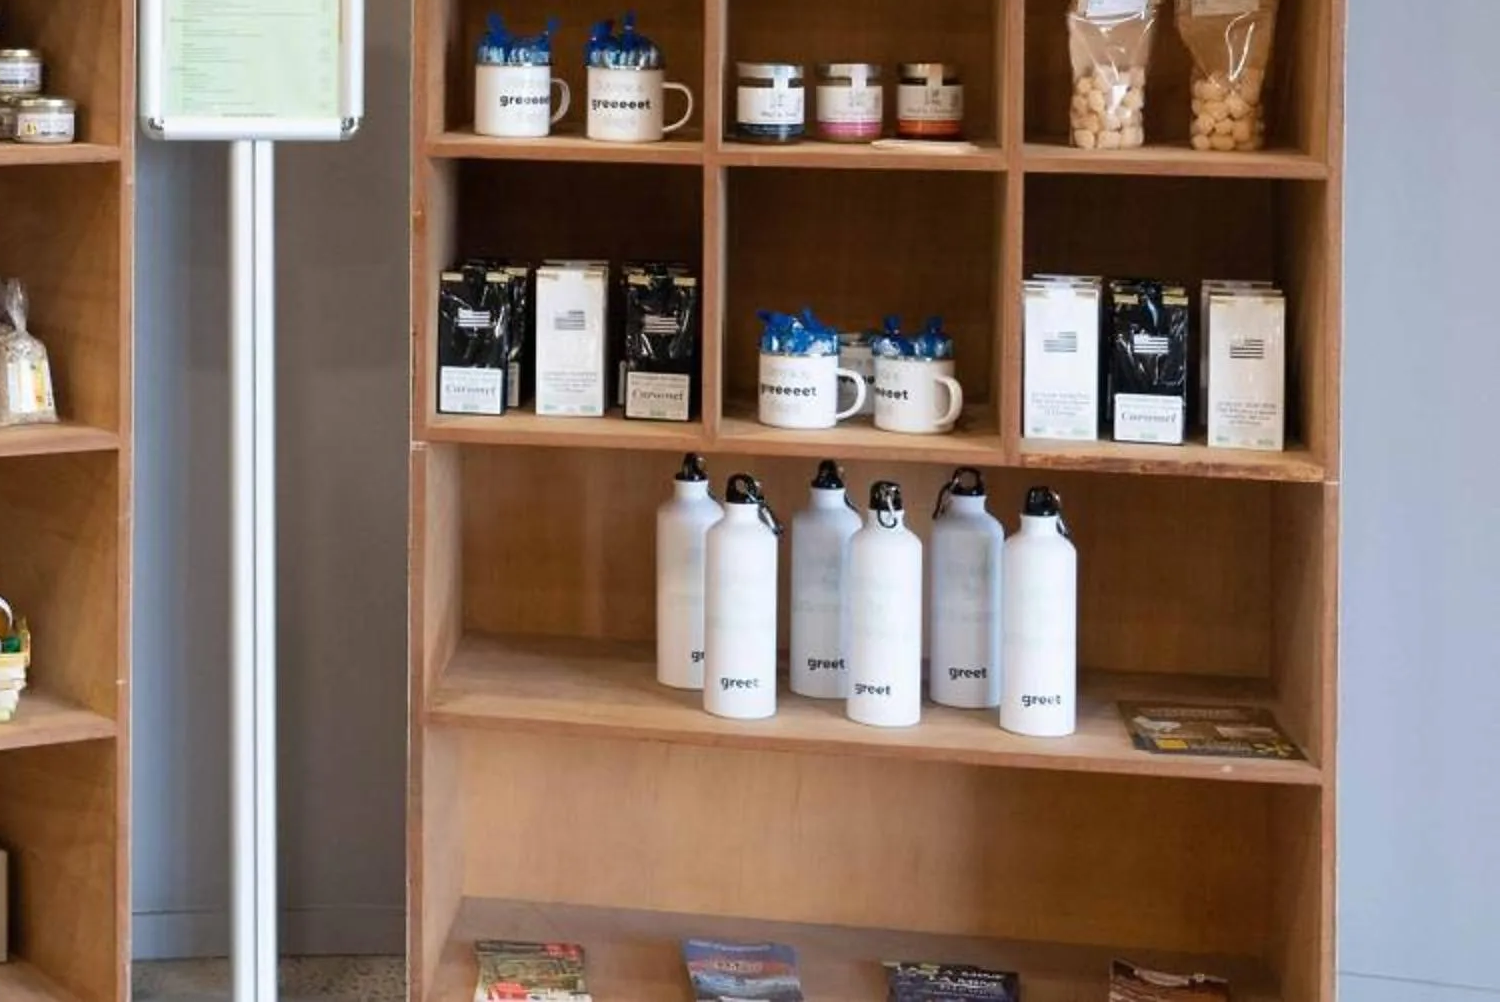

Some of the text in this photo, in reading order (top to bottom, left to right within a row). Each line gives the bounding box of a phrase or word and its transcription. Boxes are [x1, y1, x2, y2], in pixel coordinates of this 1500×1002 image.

[807, 657, 845, 670] greet
[948, 666, 987, 680] greet
[720, 676, 760, 690] greet
[854, 682, 891, 696] greet
[1021, 693, 1061, 707] greet
